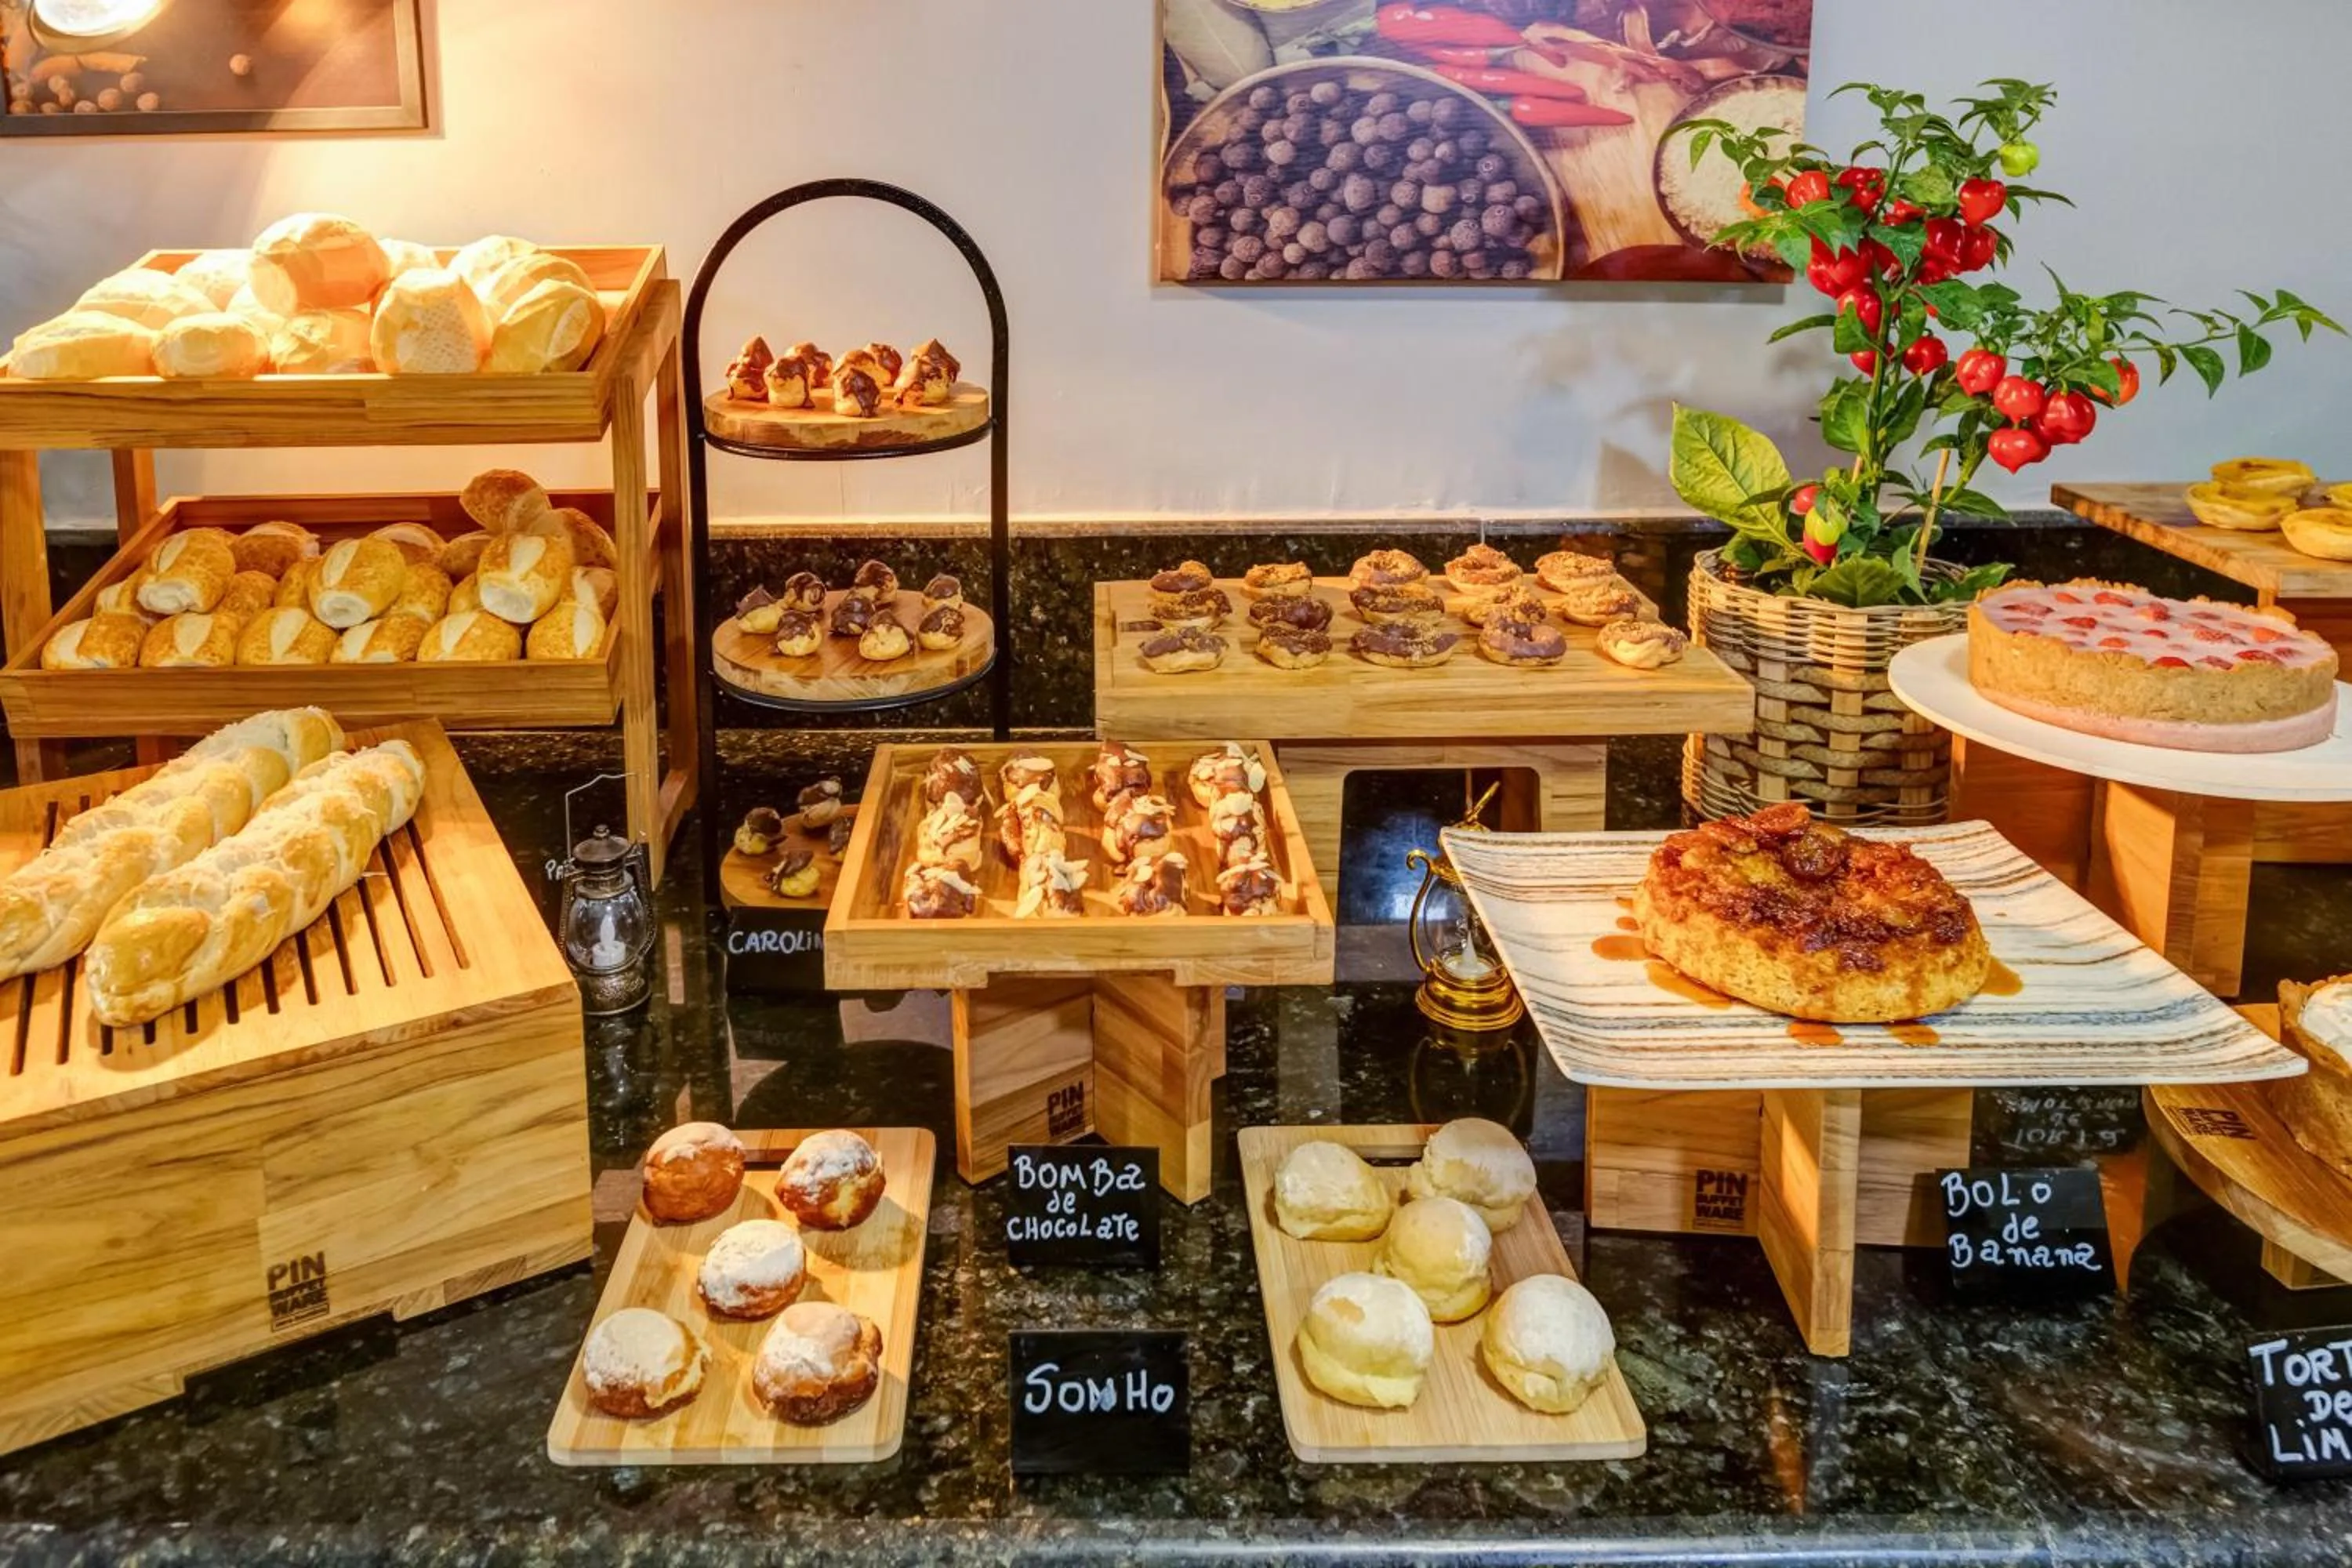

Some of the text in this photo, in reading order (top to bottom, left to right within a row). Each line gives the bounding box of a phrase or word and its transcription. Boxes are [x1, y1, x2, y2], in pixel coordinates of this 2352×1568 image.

[1047, 1080, 1083, 1114] PIN
[2208, 1110, 2257, 1139] PIN
[1695, 1169, 1747, 1195] PIN
[1046, 1189, 1076, 1214] de
[2002, 1212, 2040, 1244] de
[1947, 1232, 2102, 1269] Banana
[267, 1250, 325, 1290] PIN
